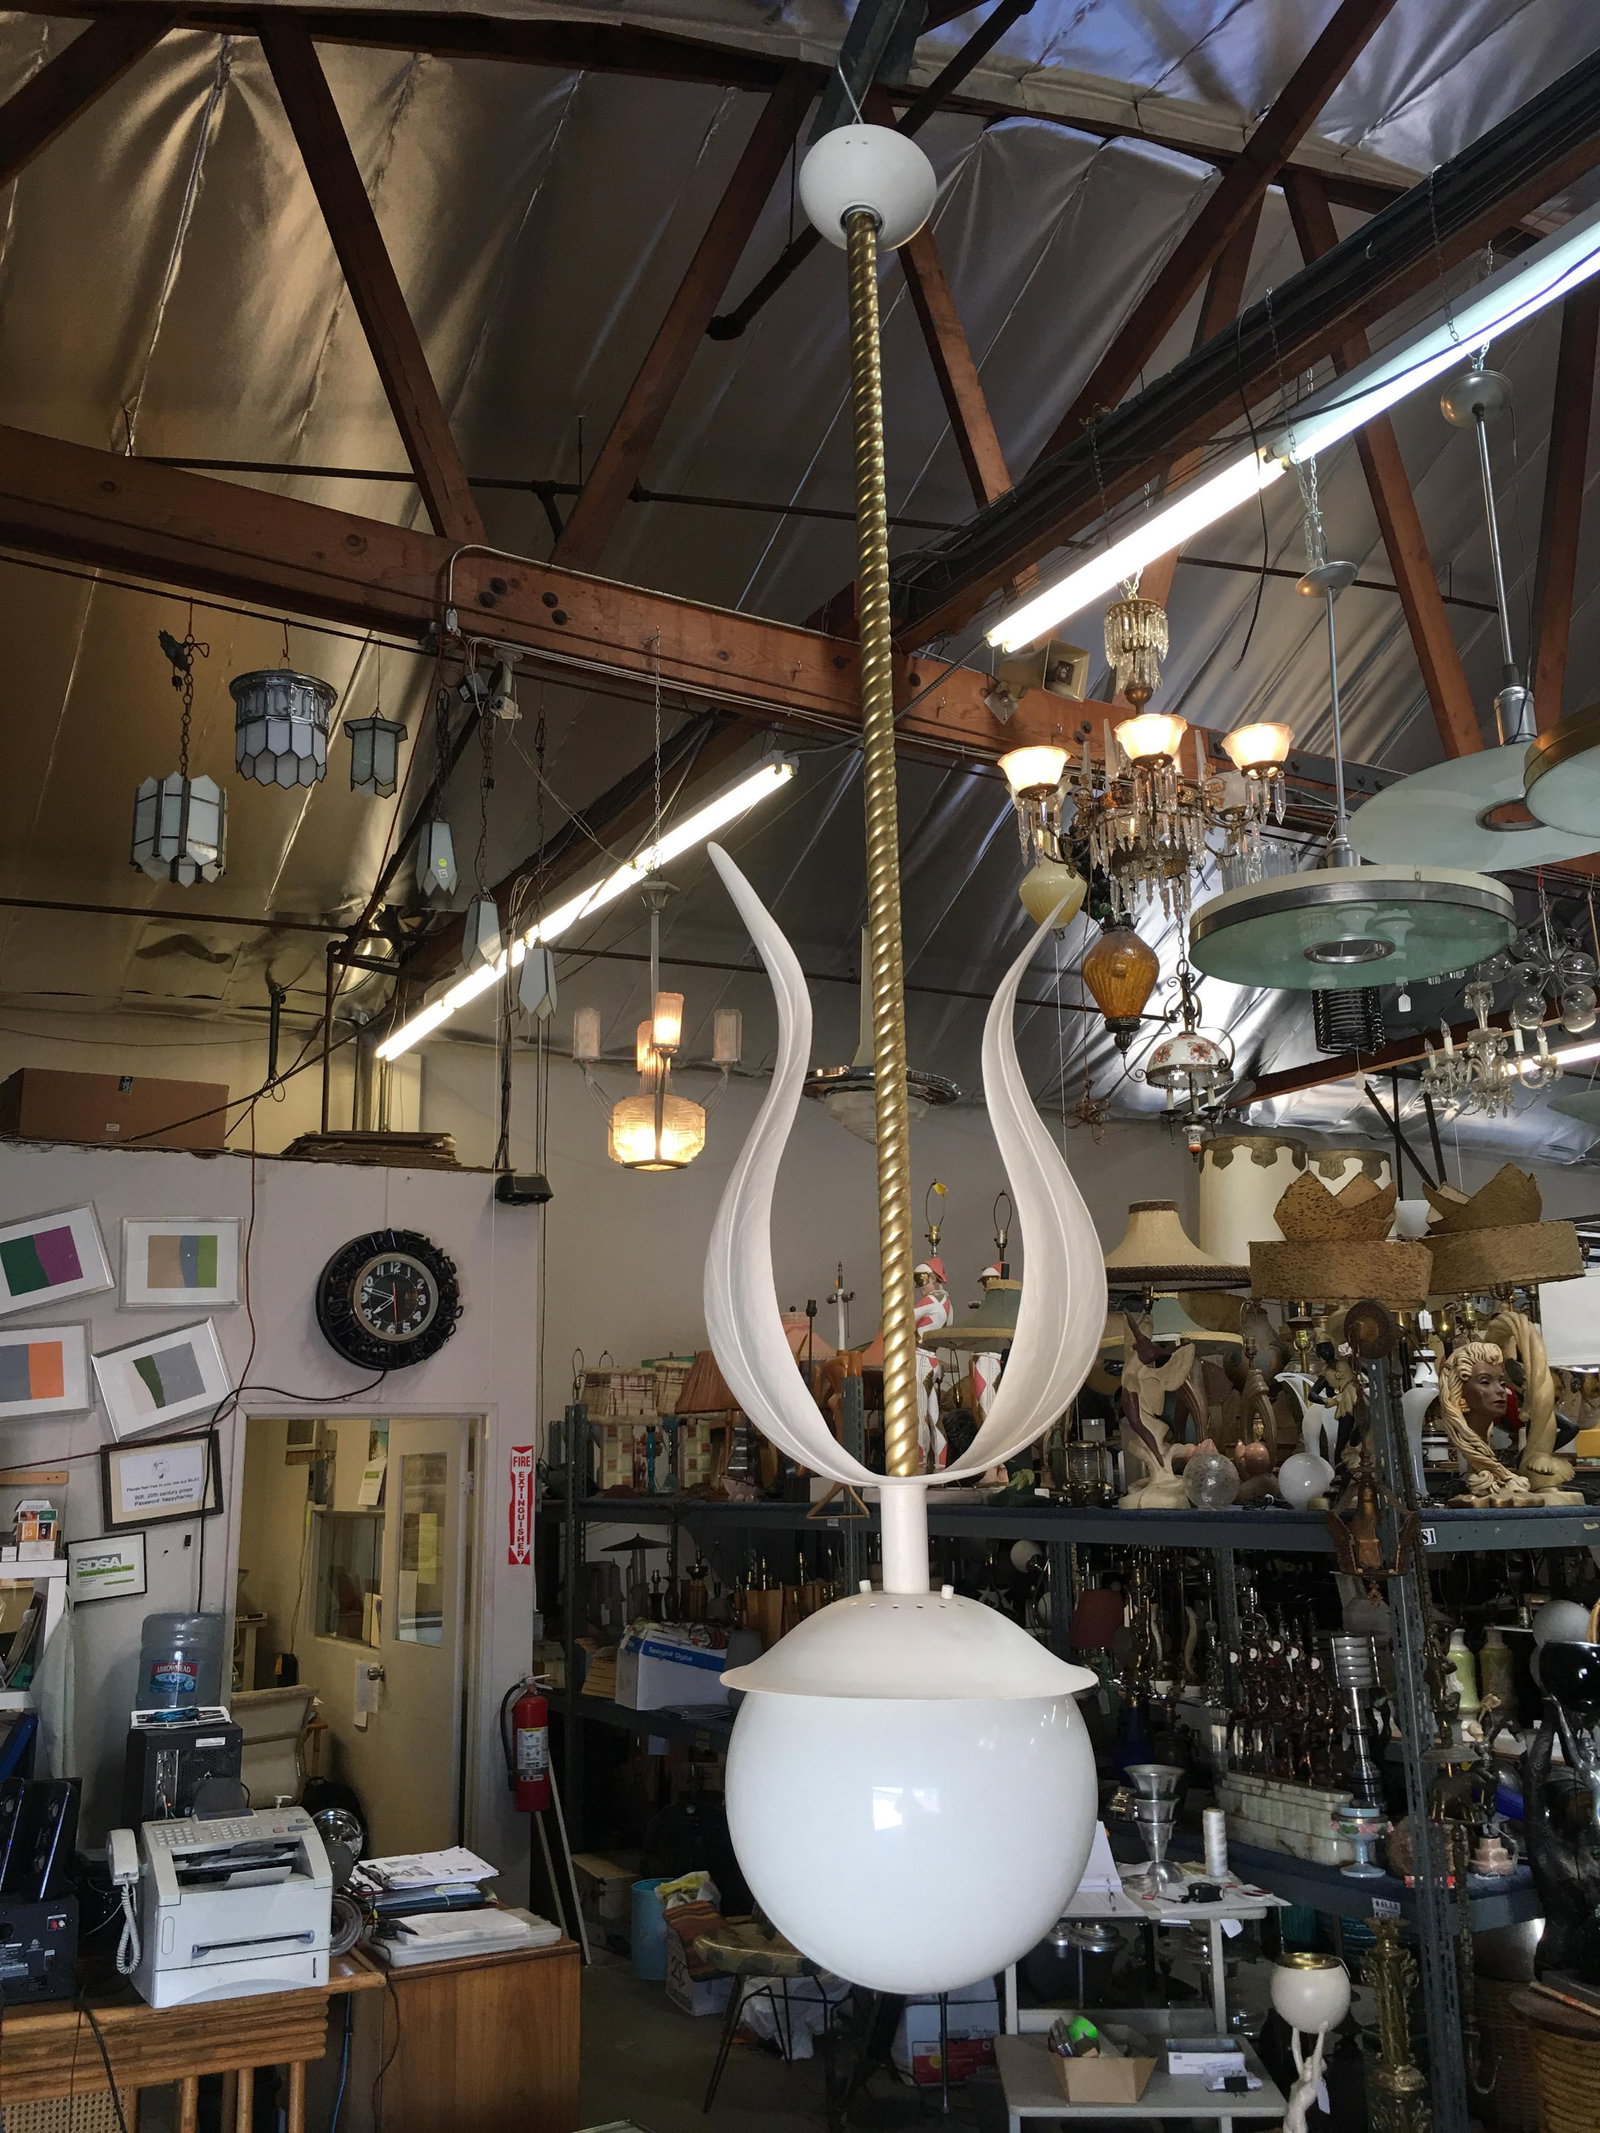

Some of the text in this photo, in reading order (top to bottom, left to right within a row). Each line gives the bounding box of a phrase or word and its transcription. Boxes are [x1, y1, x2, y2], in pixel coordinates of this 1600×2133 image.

[376, 1265, 384, 1276] 11
[390, 1261, 401, 1273] 12
[417, 1279, 424, 1289] 2
[360, 1292, 368, 1303] 9
[418, 1294, 426, 1305] 3
[363, 1308, 372, 1320] 8
[412, 1311, 422, 1321] 4
[373, 1320, 381, 1328] 7
[387, 1324, 396, 1334] 6
[402, 1322, 411, 1332] 5
[513, 1456, 530, 1467] FIRE
[517, 1471, 525, 1557] EXTINGUISHER
[77, 1556, 121, 1572] SDSA
